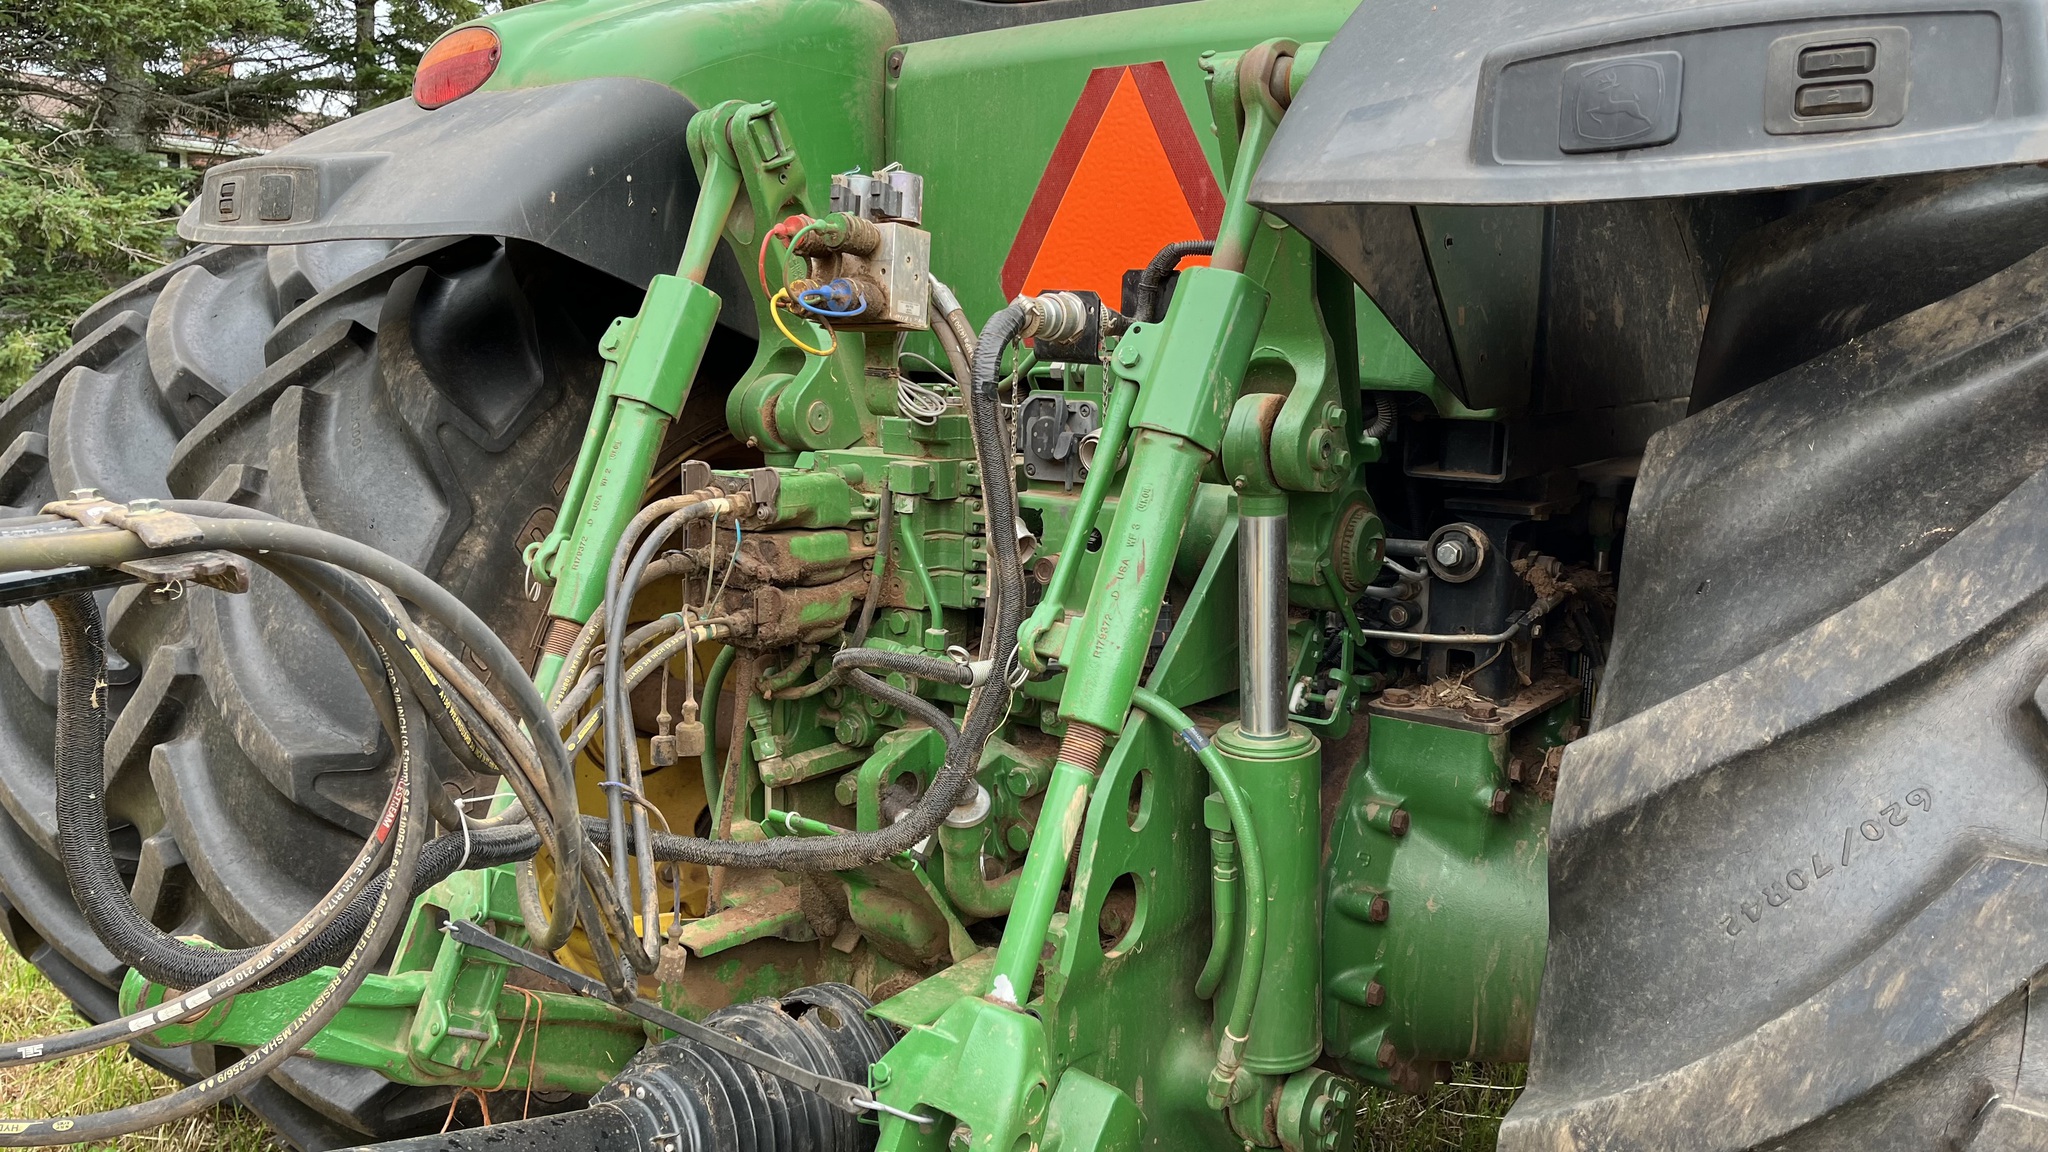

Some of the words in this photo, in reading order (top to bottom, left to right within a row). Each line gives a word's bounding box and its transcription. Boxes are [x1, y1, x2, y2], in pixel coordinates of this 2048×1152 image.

[591, 494, 603, 512] USA
[1093, 614, 1113, 659] R179372
[1117, 558, 1130, 581] USA
[392, 688, 402, 703] 3/8
[397, 705, 408, 734] INCH
[401, 789, 410, 812] SAE
[391, 815, 407, 867] 100R16-6
[353, 854, 371, 876] SAE
[1720, 787, 1932, 937] 620/70R42
[342, 876, 356, 893] 100
[319, 893, 344, 917] R17-1
[371, 893, 390, 918] 4800
[296, 921, 315, 940] 3/8"
[361, 917, 378, 938] PSI
[273, 938, 296, 955] Max.
[337, 938, 369, 977] FLAME
[237, 964, 256, 982] 210
[256, 953, 275, 970] WP
[216, 977, 236, 992] Bar
[292, 976, 342, 1030] RESISTANT
[261, 1027, 292, 1054] MSHA
[216, 1052, 260, 1084] IC-256/9
